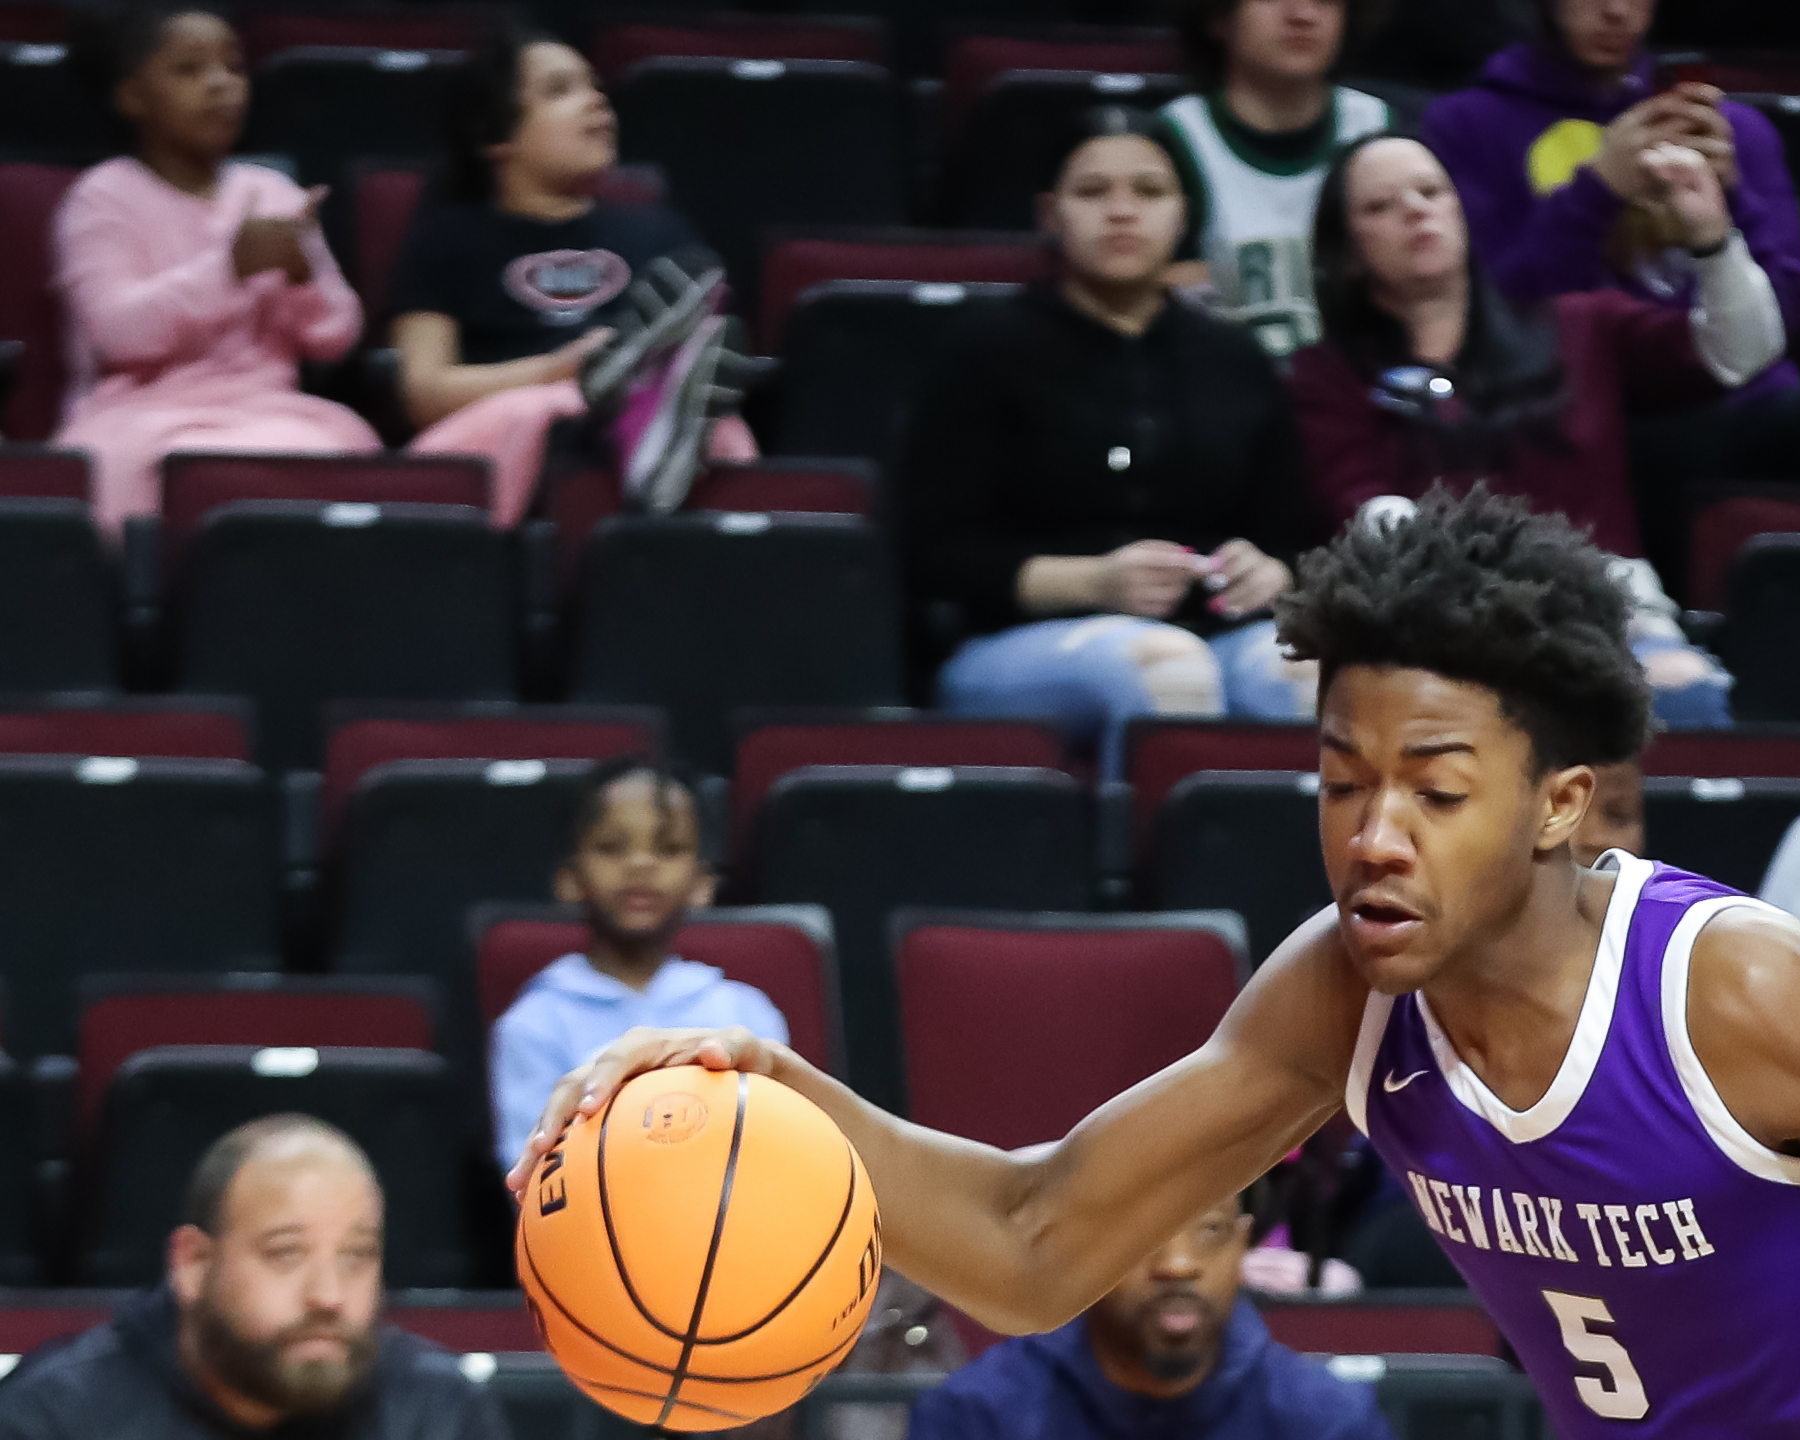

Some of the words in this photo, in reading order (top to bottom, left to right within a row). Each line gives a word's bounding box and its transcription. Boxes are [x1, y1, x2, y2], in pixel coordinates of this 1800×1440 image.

[540, 1130, 569, 1217] EV
[1406, 1170, 1580, 1263] NEWARK
[1575, 1197, 1716, 1268] TECH
[1541, 1289, 1651, 1420] 5
